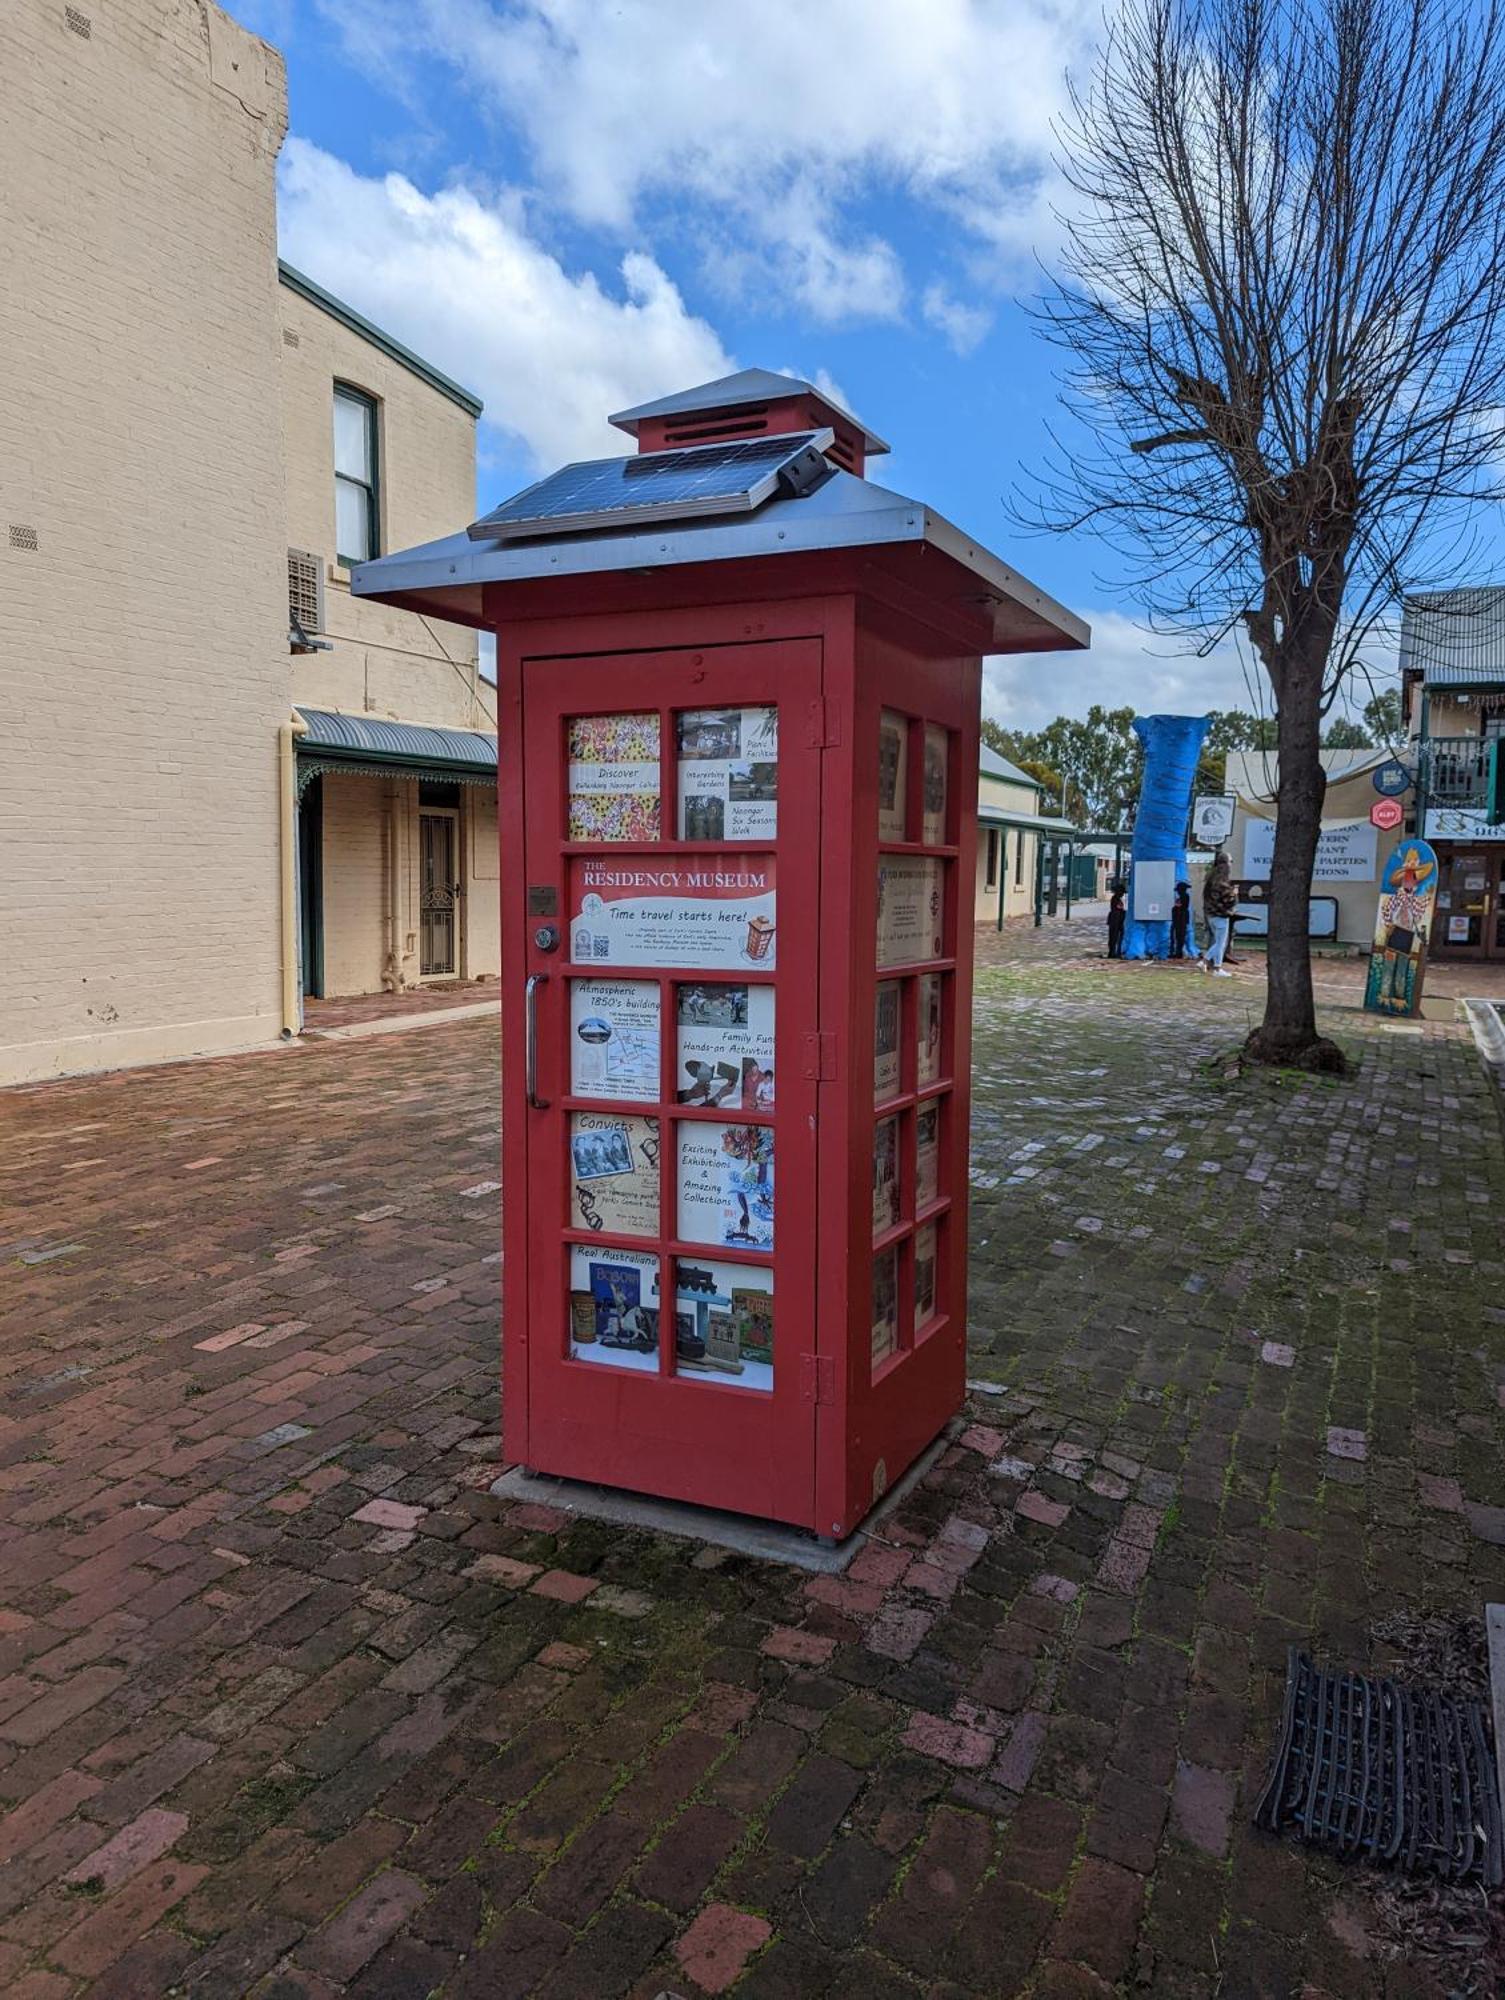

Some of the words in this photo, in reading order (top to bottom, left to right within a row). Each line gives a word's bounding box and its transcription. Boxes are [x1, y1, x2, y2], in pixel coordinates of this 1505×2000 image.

[598, 768, 639, 778] Discover
[584, 862, 606, 870] THE
[1319, 857, 1368, 866] PARTIES
[584, 872, 683, 888] RESIDENCY
[687, 873, 765, 888] MUSEUM
[609, 907, 635, 920] Time
[641, 911, 675, 922] travel
[678, 911, 713, 922] starts
[718, 911, 748, 923] here!
[579, 983, 636, 996] Atmospheric
[591, 996, 622, 1008] 1850's
[722, 1031, 752, 1044] Family
[683, 1041, 725, 1053] Hands-on
[729, 1044, 774, 1056] Activities
[580, 1116, 635, 1132] Convicts
[682, 1143, 718, 1157] Exciting
[682, 1155, 731, 1169] Exhibitions
[701, 1170, 709, 1178] &
[684, 1179, 722, 1194] Amazing
[684, 1192, 732, 1206] Collections
[577, 1246, 598, 1258] Real
[602, 1249, 657, 1266] Australians
